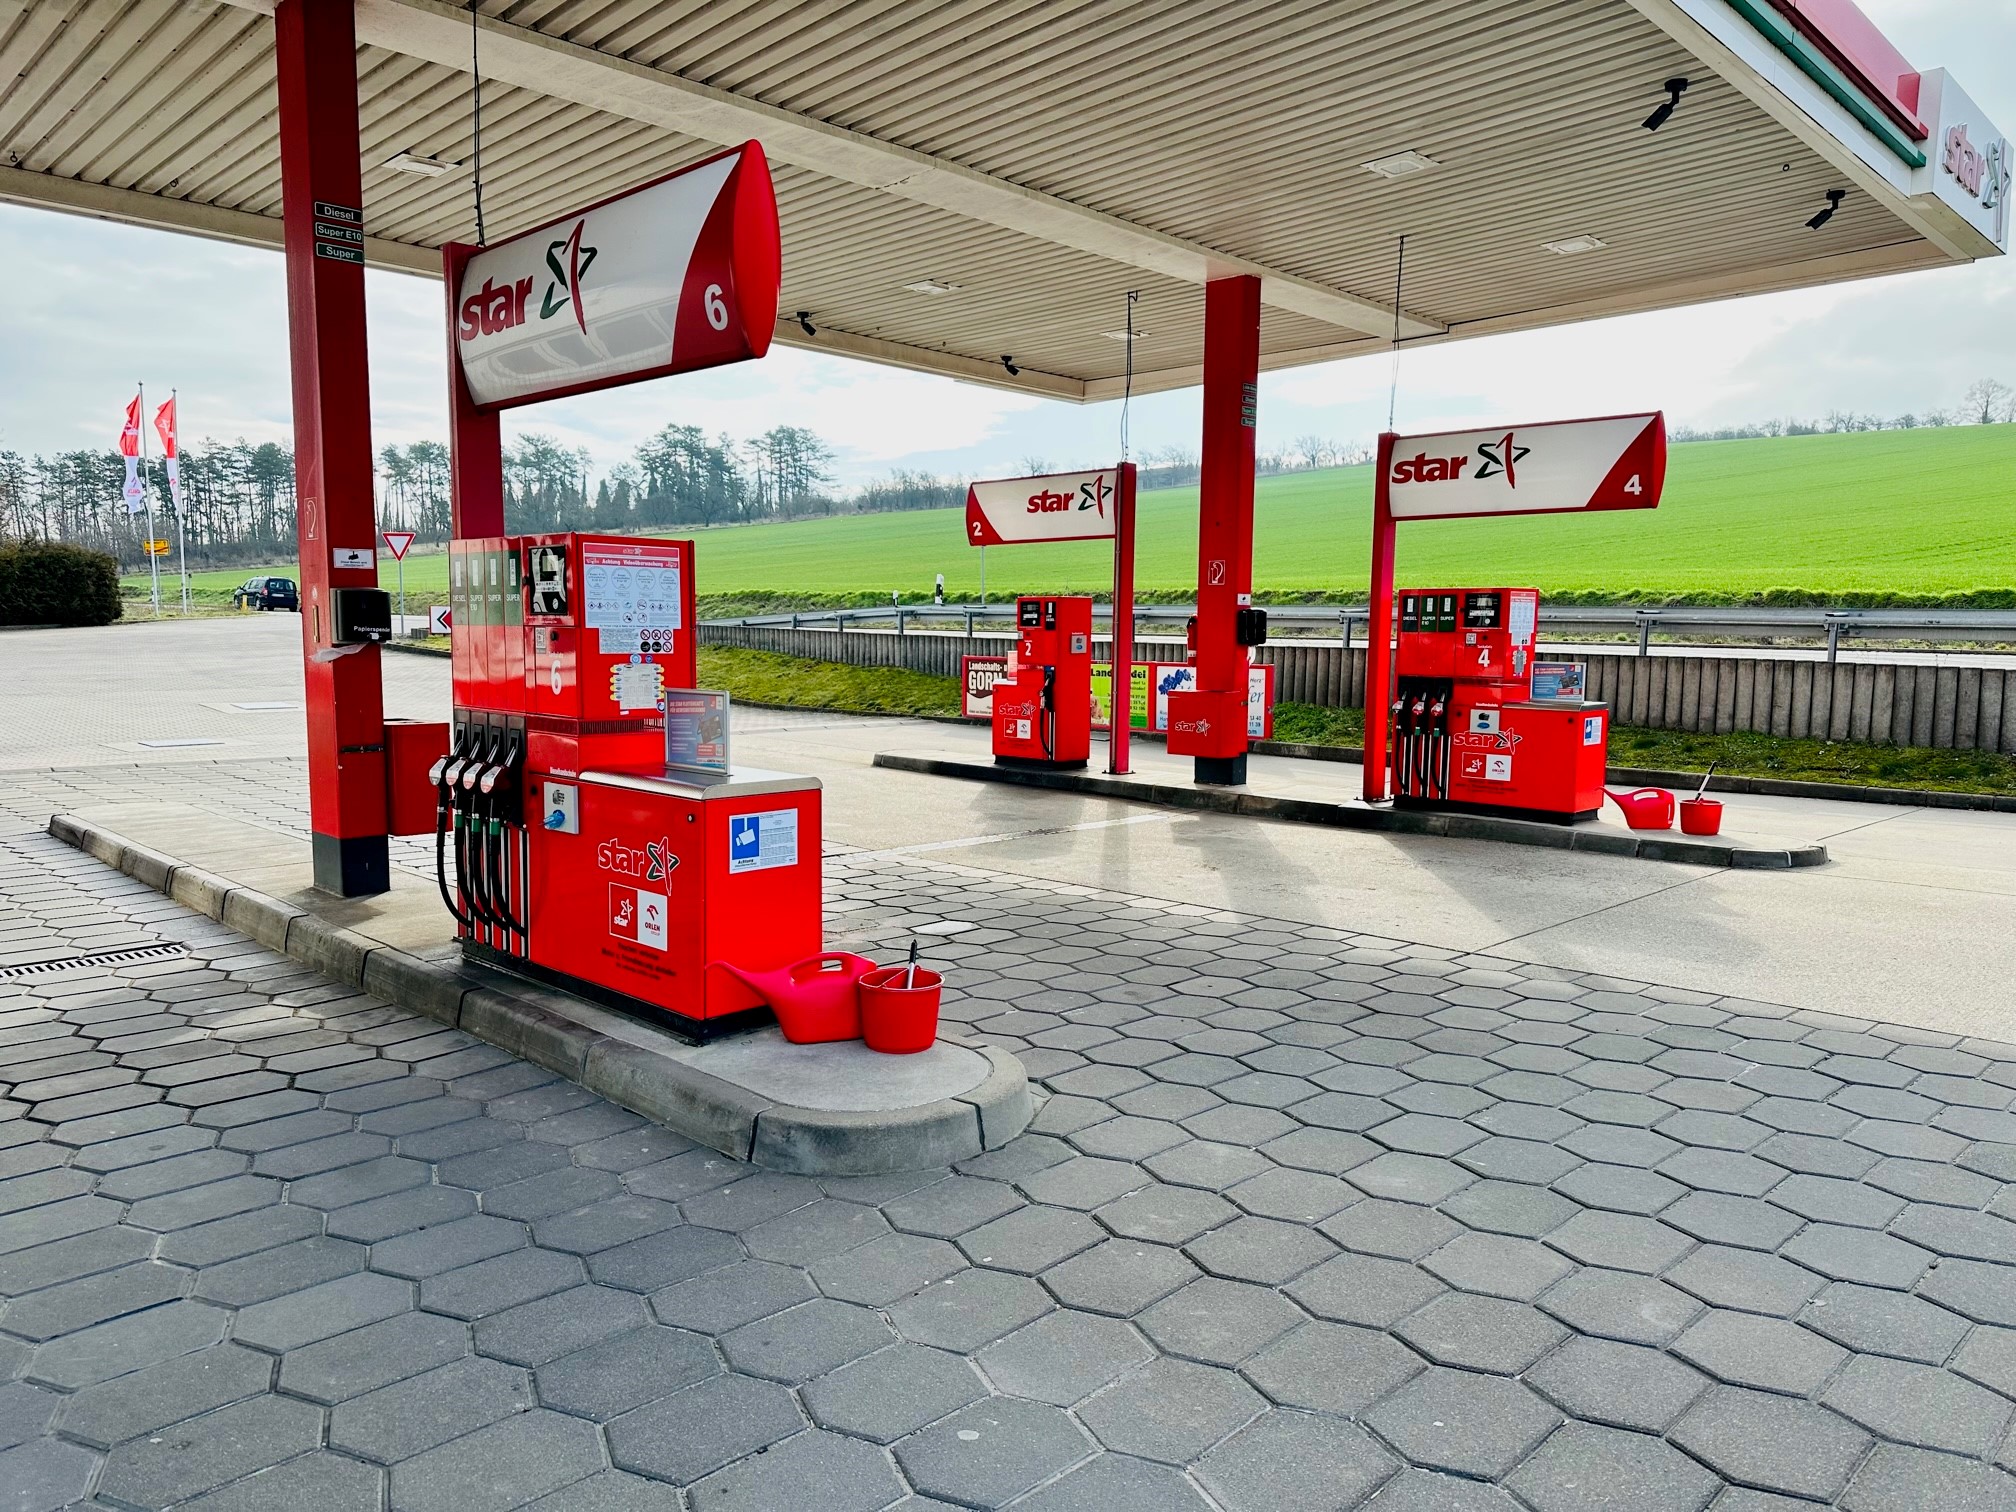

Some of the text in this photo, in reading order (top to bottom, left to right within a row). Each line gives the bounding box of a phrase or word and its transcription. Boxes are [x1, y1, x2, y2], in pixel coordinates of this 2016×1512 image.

[1942, 122, 1986, 198] star
[324, 206, 354, 220] Diesel
[318, 225, 362, 241] Super E10
[326, 246, 355, 260] Super
[460, 275, 534, 341] star
[703, 284, 729, 331] 6
[1391, 452, 1468, 484] star
[1623, 474, 1643, 496] 4
[1026, 489, 1075, 514] star
[972, 521, 983, 537] 2
[601, 558, 621, 566] Achtung
[469, 594, 484, 602] SUPER
[487, 594, 502, 602] SUPER
[506, 593, 520, 602] SUPER
[1025, 643, 1032, 656] 2
[1477, 649, 1490, 668] 4
[550, 660, 562, 695] 6
[999, 703, 1021, 715] star
[1175, 720, 1195, 732] star
[1453, 730, 1494, 748] star
[598, 838, 645, 877] star
[614, 915, 628, 927] star
[645, 921, 661, 932] ORLEN
